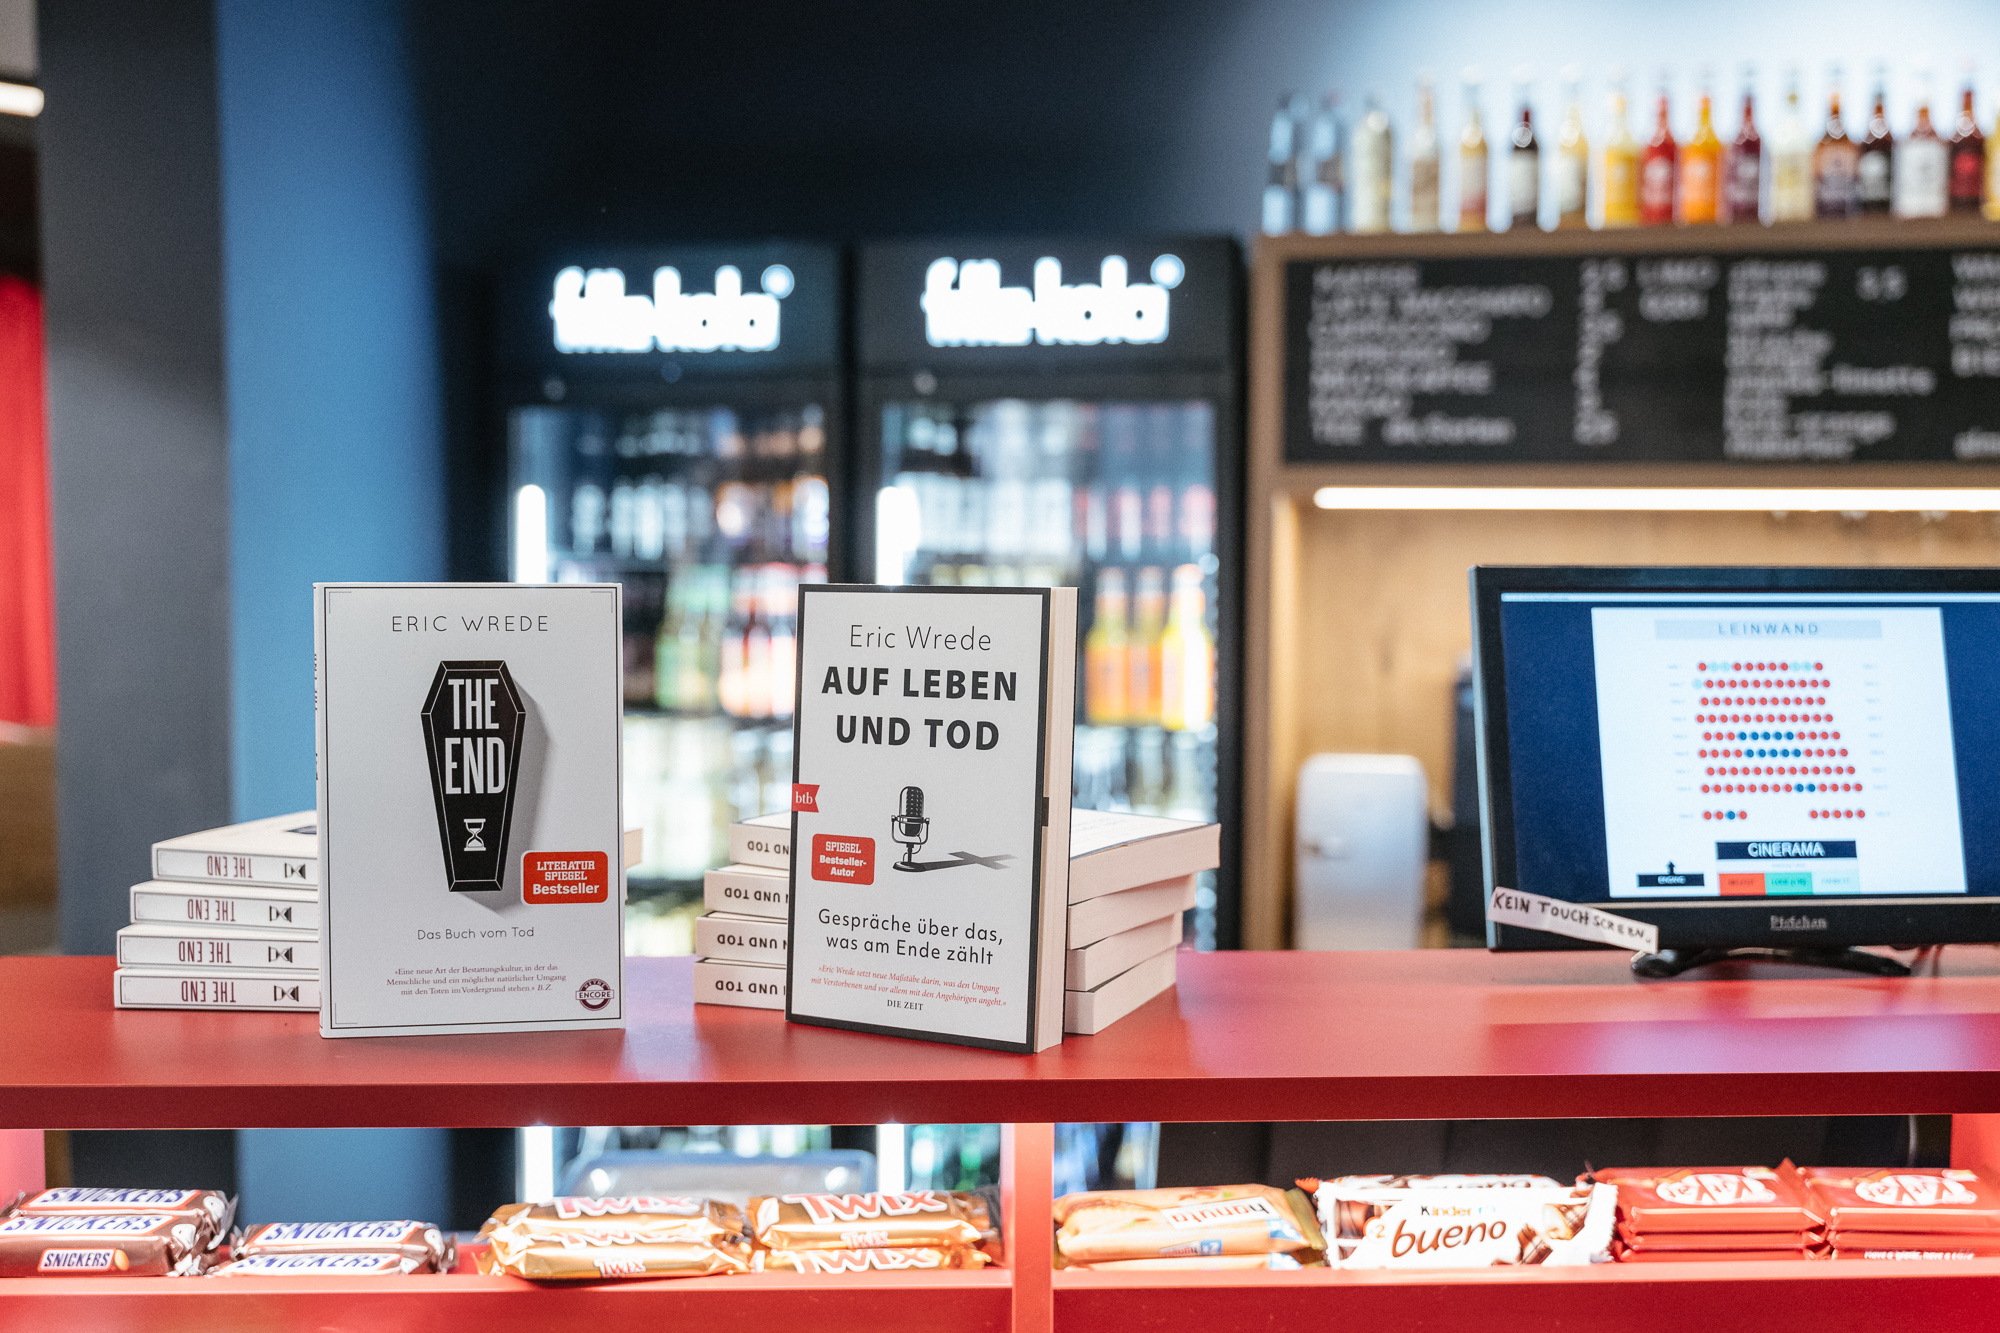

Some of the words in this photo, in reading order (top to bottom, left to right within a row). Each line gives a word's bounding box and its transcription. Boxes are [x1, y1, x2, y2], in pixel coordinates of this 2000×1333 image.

[392, 616, 447, 632] ERIC
[461, 615, 549, 632] WREDE
[1718, 623, 1819, 635] LEINWAND
[850, 624, 896, 649] Eric
[906, 625, 991, 651] Wrede
[821, 666, 889, 696] AUF
[903, 668, 1017, 701] LEBEN
[448, 678, 500, 730] THE
[836, 714, 911, 746] UND
[924, 718, 1000, 750] TOD
[444, 737, 506, 795] END
[795, 791, 813, 804] btb
[747, 840, 769, 853] TOD
[774, 844, 790, 855] ND
[825, 841, 861, 853] SPIEGEL
[1748, 841, 1826, 857] CINERAMA
[207, 855, 228, 877] END
[233, 856, 253, 878] THE
[537, 860, 595, 871] LITERATUR
[819, 854, 867, 867] Bestseller-
[544, 870, 588, 881] SPIEGEL
[830, 867, 855, 877] Autor
[532, 881, 600, 895] Bestseller
[724, 887, 750, 900] TOD
[754, 890, 780, 903] UND
[1493, 892, 1530, 914] KEIN
[187, 898, 209, 920] END
[215, 900, 236, 922] THE
[417, 929, 441, 940] Das
[445, 928, 476, 940] Buch
[480, 929, 507, 939] vom
[511, 926, 535, 938] Tod
[818, 908, 911, 933] Gespräche
[917, 918, 959, 937] über
[965, 922, 1003, 945] das,
[717, 934, 745, 946] TOD
[749, 937, 777, 949] UND
[178, 940, 202, 962] END
[209, 942, 232, 963] THE
[826, 935, 858, 950] was
[863, 940, 890, 954] am
[896, 940, 941, 960] Ende
[946, 946, 993, 965] zählt
[416, 967, 434, 975] neue
[448, 966, 461, 974] der
[534, 963, 546, 971] der
[547, 963, 558, 971] das
[386, 977, 431, 986] Menschliche
[433, 977, 447, 985] und
[462, 975, 495, 985] möglichst
[497, 974, 534, 983] natürlicher
[536, 973, 567, 983] Umgang
[715, 979, 744, 992] TOD
[836, 965, 856, 975] Wrede
[856, 967, 871, 977] setzt
[872, 971, 888, 979] neue
[921, 976, 942, 987] darin,
[943, 980, 956, 988] was
[957, 979, 970, 989] den
[971, 982, 1000, 994] Umgang
[181, 980, 206, 1002] END
[212, 981, 237, 1003] THE
[415, 987, 428, 995] den
[429, 986, 449, 994] Toten
[462, 985, 506, 995] Vordergrund
[748, 983, 778, 995] UND
[810, 976, 822, 985] mit
[823, 977, 863, 989] Verstorbenen
[864, 981, 877, 991] und
[878, 984, 889, 992] vor
[889, 984, 908, 994] allem
[909, 987, 921, 996] mit
[922, 988, 934, 998] den
[936, 991, 977, 1004] Angehörigen
[886, 999, 902, 1008] DIE
[904, 1001, 924, 1011] ZEIT
[41, 1188, 187, 1203] SNICKERS
[1171, 1203, 1270, 1223] hanuta
[5, 1216, 163, 1231] SNICKERS
[264, 1222, 412, 1240] SNICKERS
[1392, 1219, 1507, 1258] bueno
[44, 1252, 110, 1267] SNICKERS
[237, 1254, 389, 1268] SNICKERS
